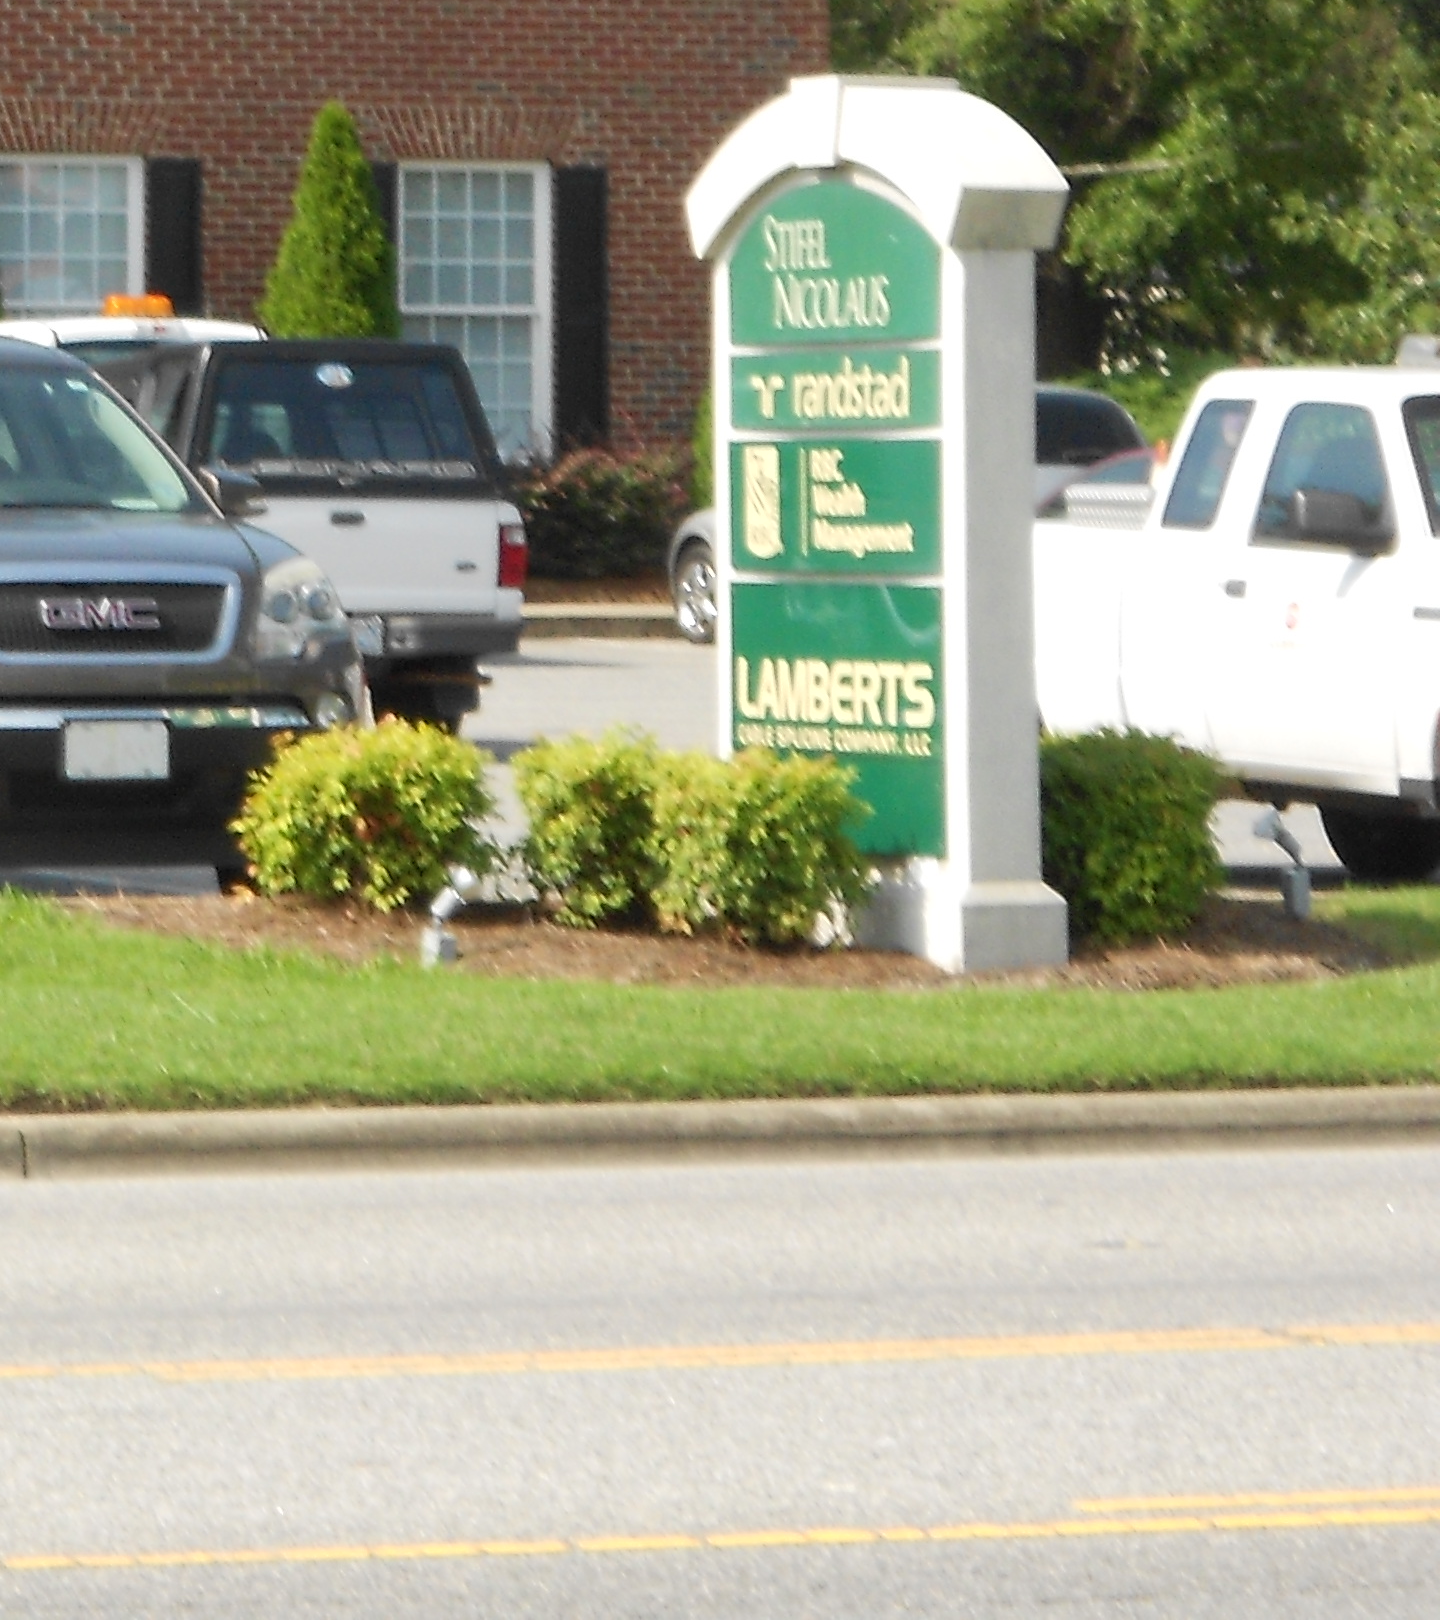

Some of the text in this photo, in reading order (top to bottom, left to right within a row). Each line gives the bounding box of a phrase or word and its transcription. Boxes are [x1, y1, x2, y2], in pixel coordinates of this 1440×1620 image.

[773, 273, 891, 330] NICOLAUS
[791, 355, 911, 419] randstad
[40, 597, 161, 629] GMC
[736, 656, 936, 729] LAMBERTS
